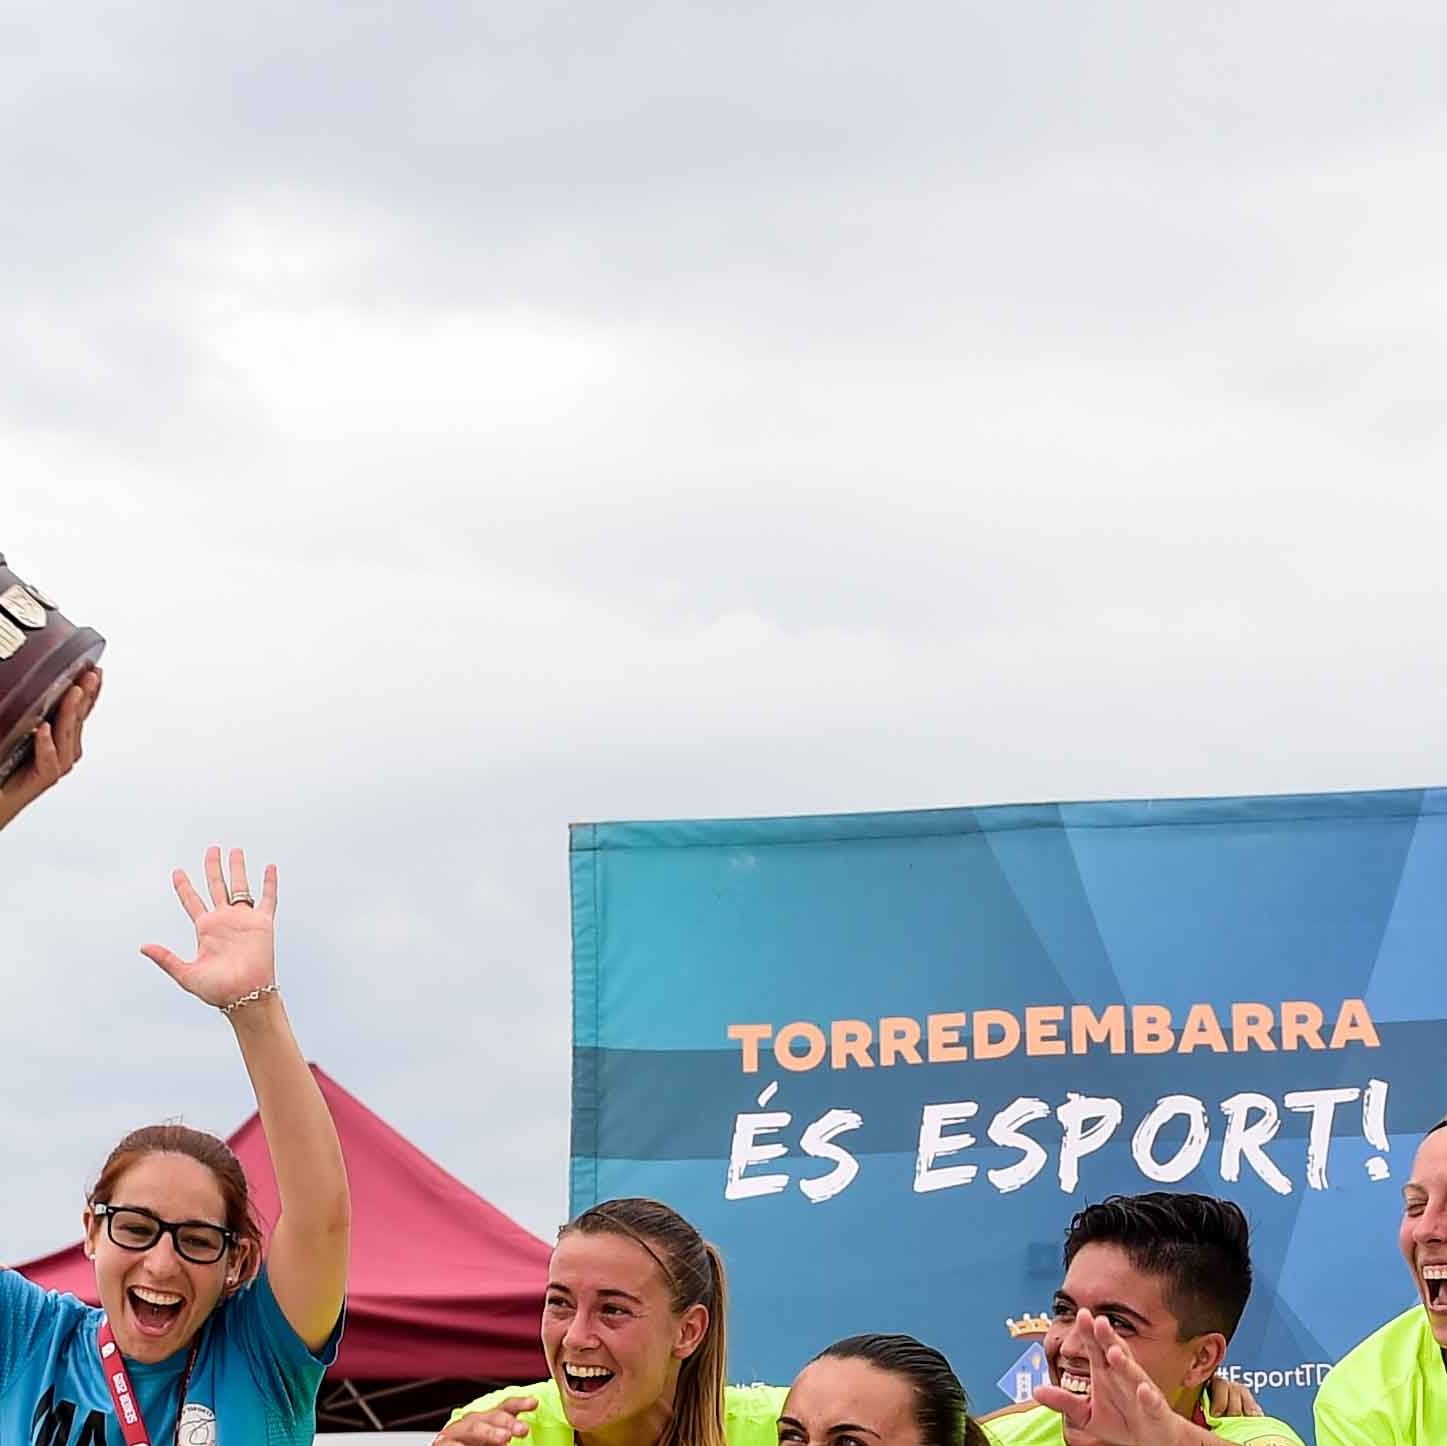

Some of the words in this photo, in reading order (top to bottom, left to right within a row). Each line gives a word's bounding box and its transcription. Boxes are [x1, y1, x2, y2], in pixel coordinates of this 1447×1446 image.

[727, 999, 1381, 1074] TORREDEMBARRA
[725, 1082, 864, 1203] ÉS
[914, 1078, 1392, 1195] ESPORT!
